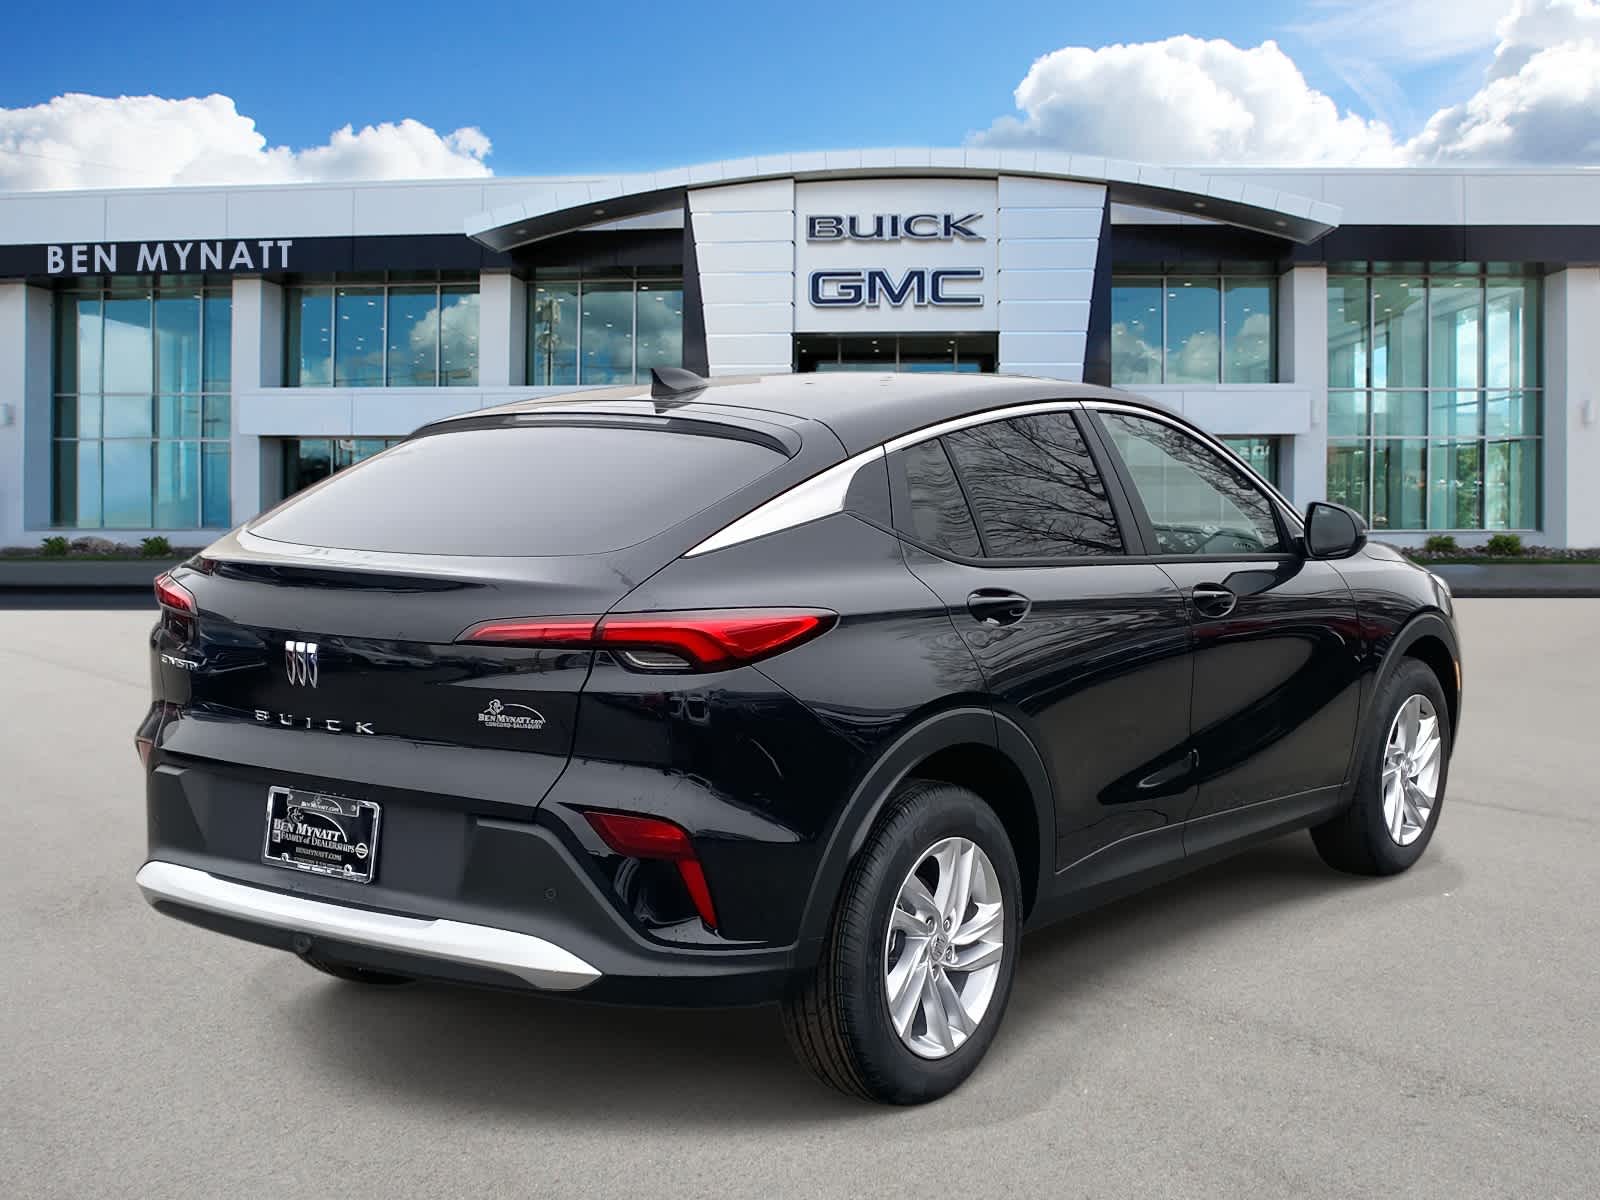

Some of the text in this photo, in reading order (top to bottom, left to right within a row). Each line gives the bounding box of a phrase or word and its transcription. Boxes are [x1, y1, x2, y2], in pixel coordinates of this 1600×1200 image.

[806, 213, 986, 241] BUICK
[47, 240, 293, 274] BEN MYNATT
[808, 267, 984, 307] GMC
[255, 709, 375, 735] BUICK
[295, 822, 341, 842] MYNATT
